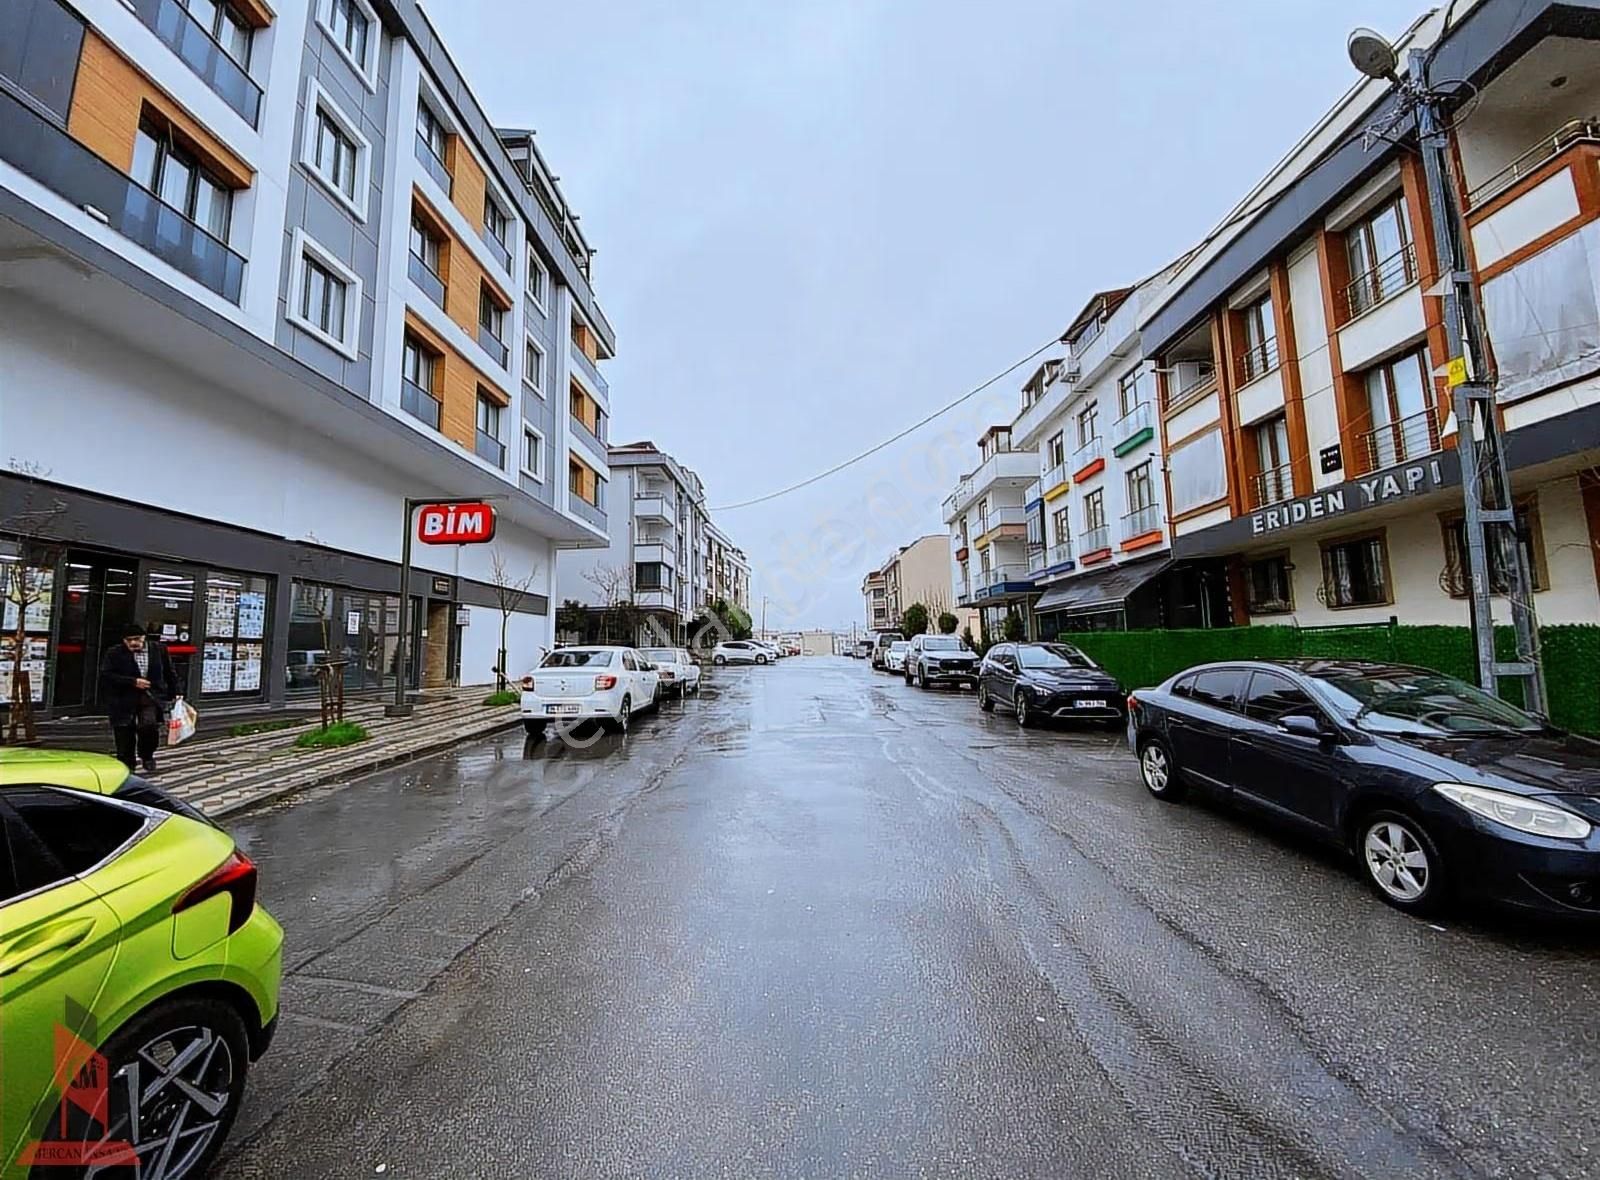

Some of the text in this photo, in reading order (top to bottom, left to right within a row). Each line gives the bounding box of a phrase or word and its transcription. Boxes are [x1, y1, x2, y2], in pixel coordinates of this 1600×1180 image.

[424, 506, 482, 536] BİM
[1251, 460, 1442, 534] ERIDEN YAPI
